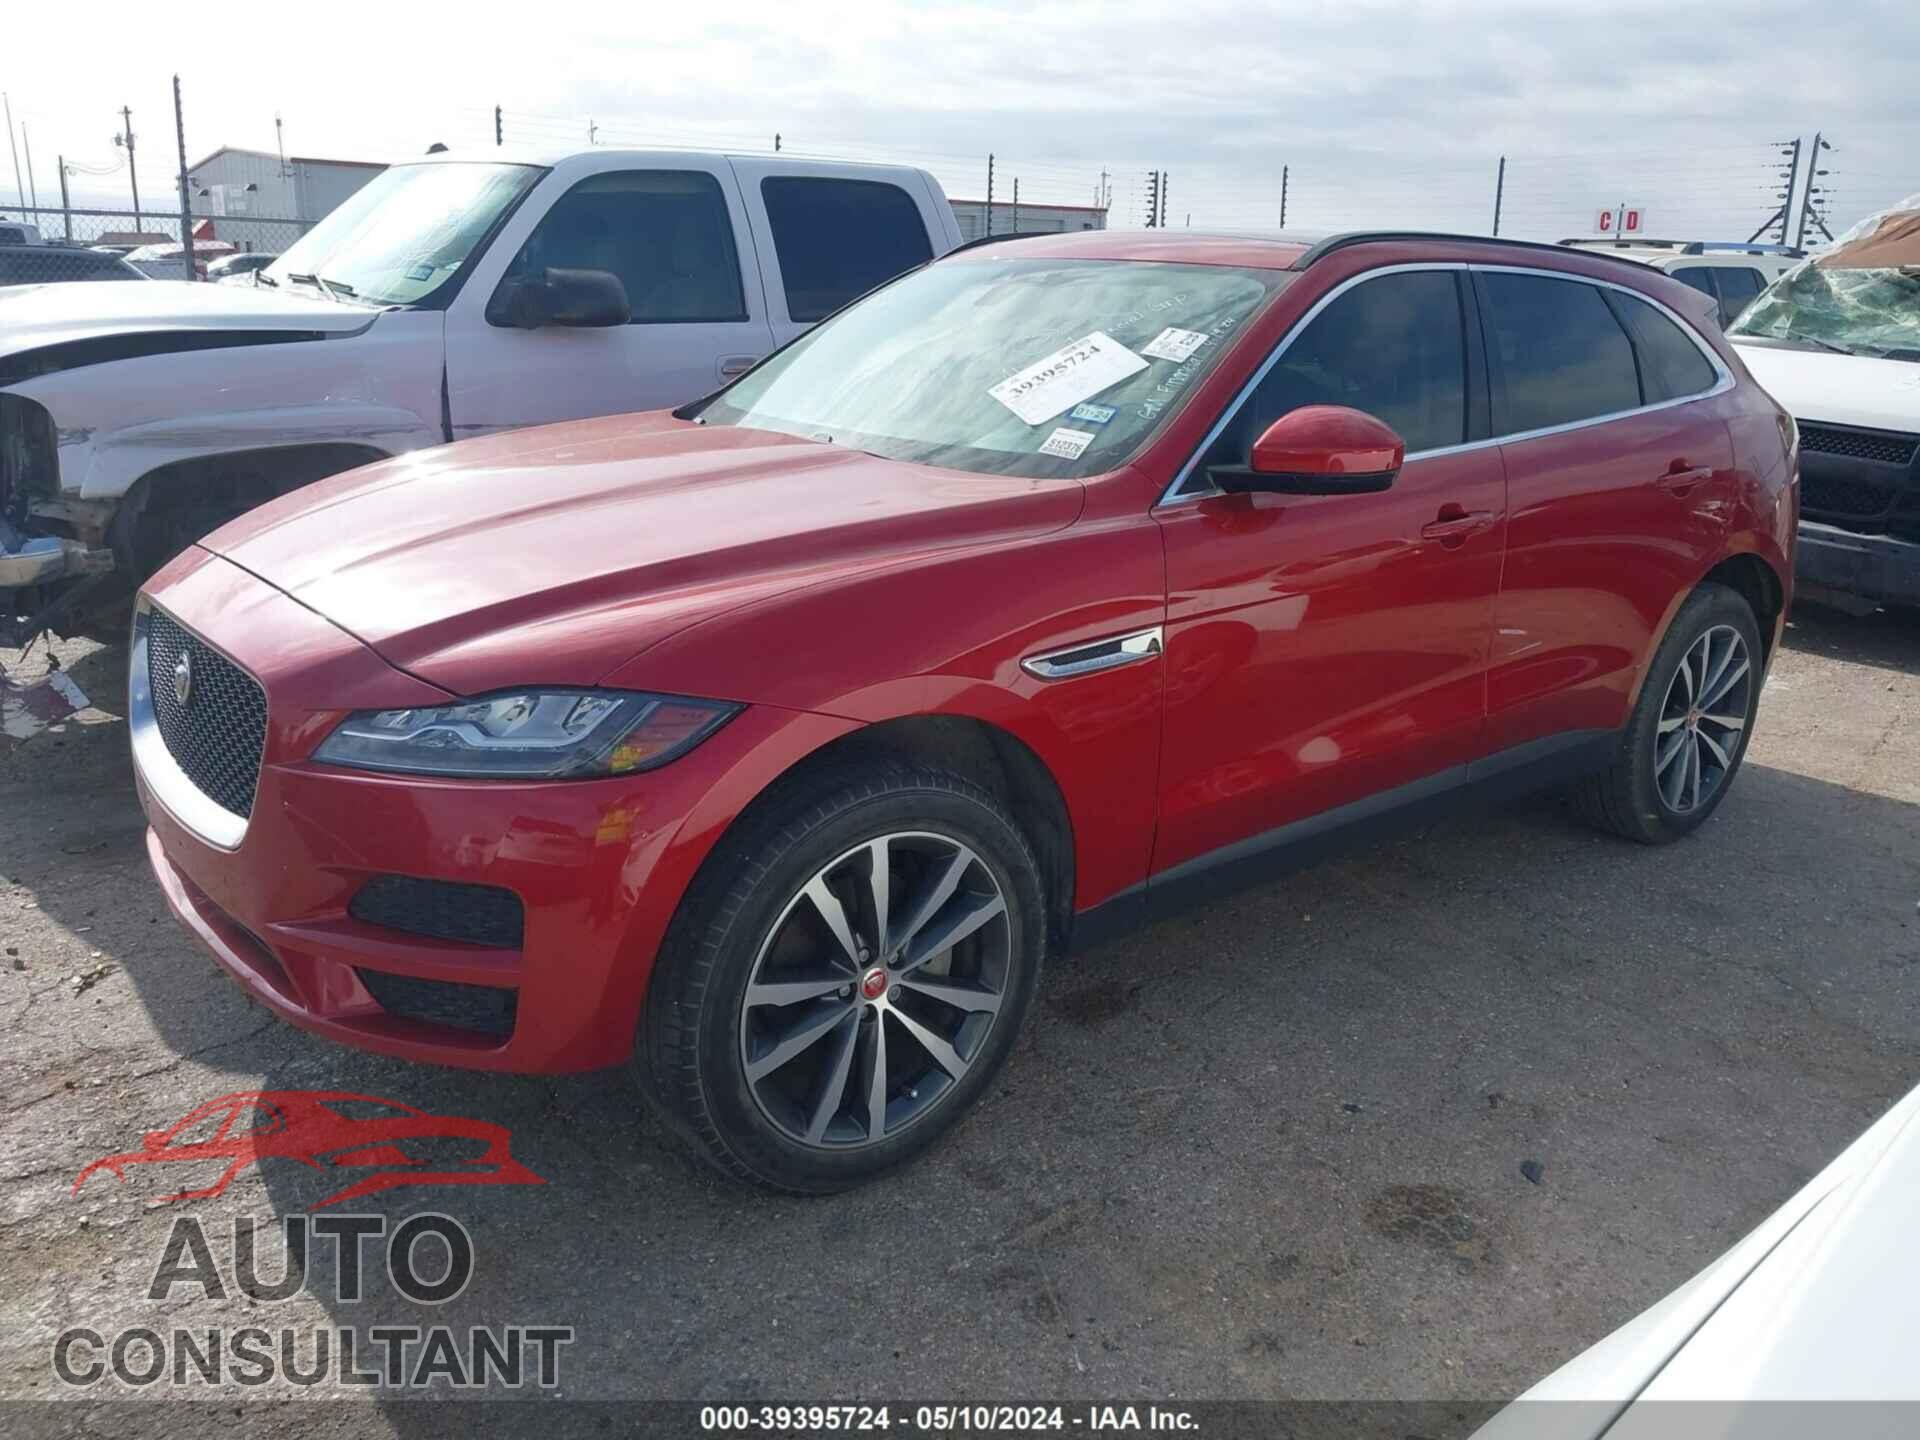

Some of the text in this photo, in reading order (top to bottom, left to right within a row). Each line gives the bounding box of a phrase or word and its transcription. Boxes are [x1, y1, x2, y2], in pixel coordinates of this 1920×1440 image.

[1600, 211, 1638, 231] C D
[1010, 344, 1101, 398] 39395724
